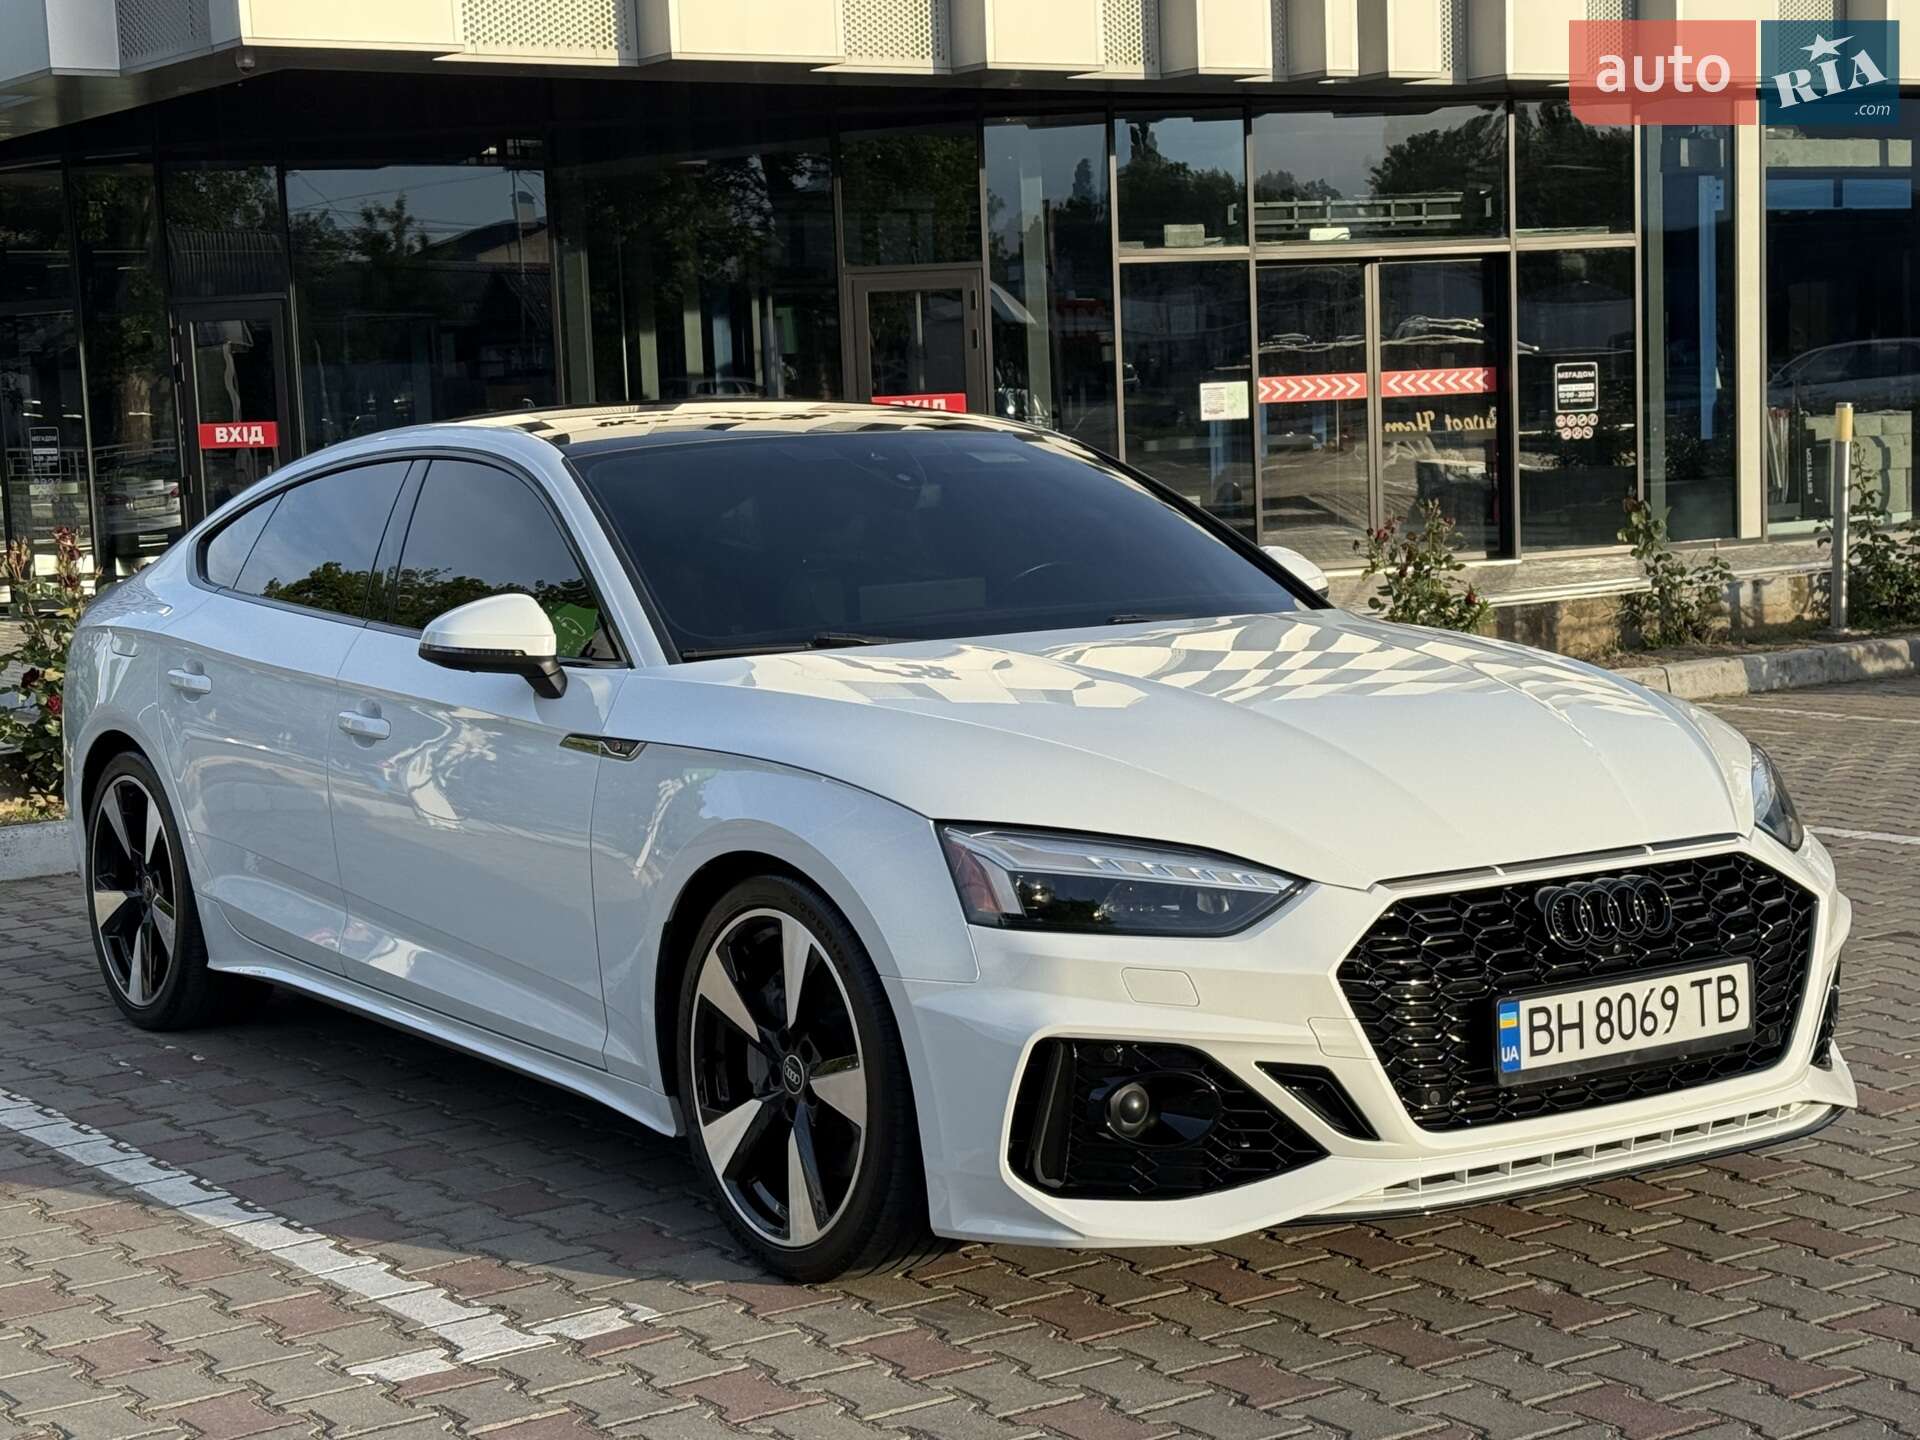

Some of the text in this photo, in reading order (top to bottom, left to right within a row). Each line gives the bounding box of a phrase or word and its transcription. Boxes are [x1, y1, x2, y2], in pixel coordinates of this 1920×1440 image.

[215, 426, 264, 445] ВХІД
[1528, 974, 1740, 1057] BH 8069 TB
[1501, 1046, 1519, 1062] UA
